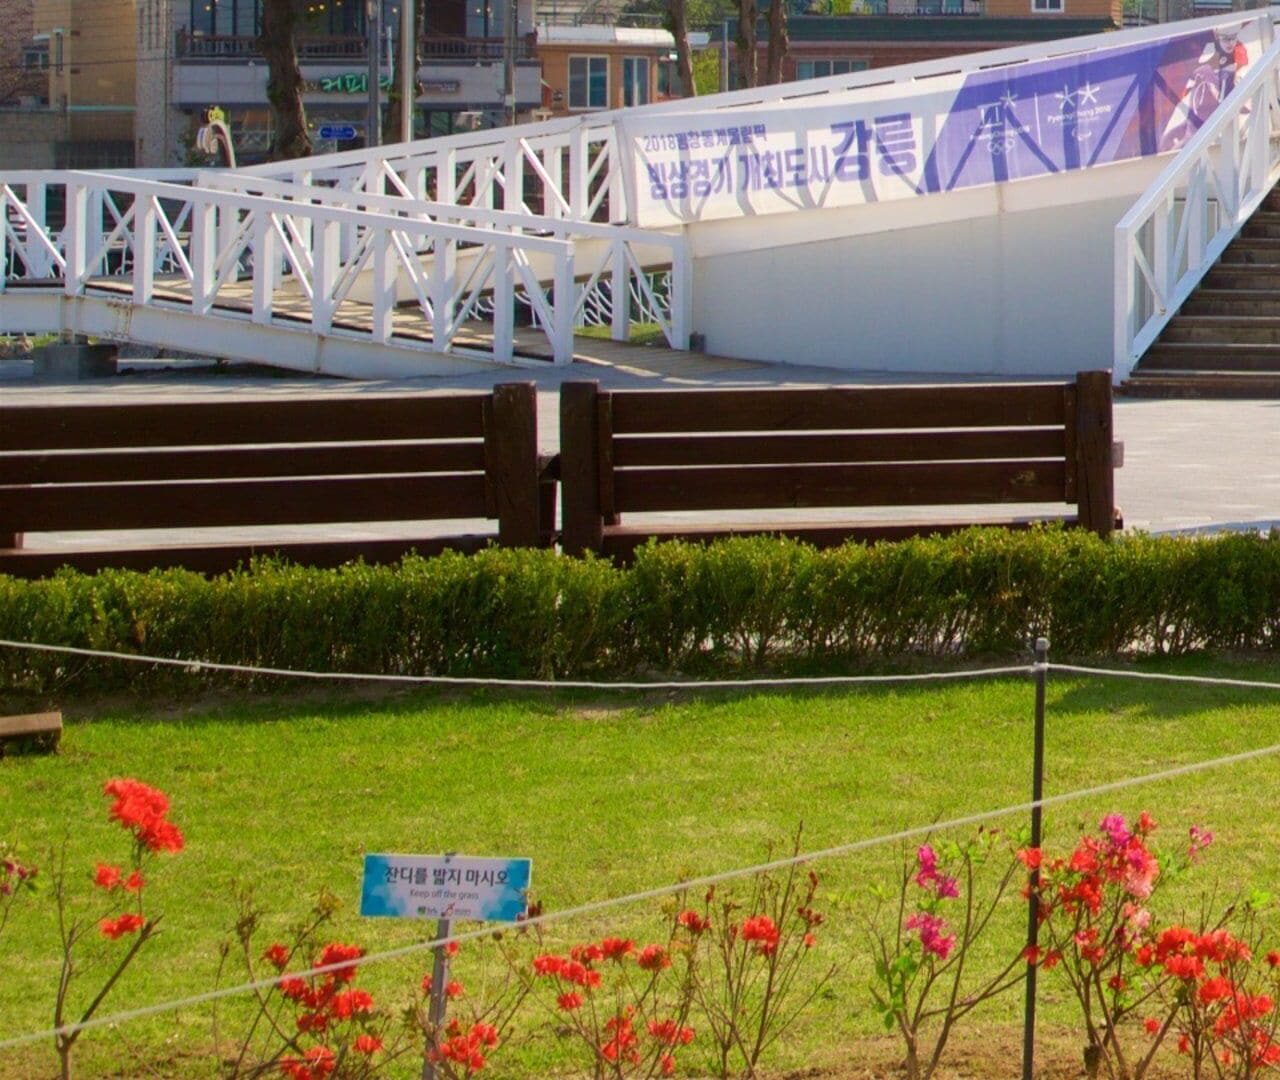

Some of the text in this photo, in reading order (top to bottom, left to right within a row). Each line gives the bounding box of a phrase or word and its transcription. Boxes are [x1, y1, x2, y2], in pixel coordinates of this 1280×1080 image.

[647, 112, 918, 201] 빙상경기 개최도시 강릉
[385, 866, 429, 885] 잔디를
[465, 868, 511, 887] 마시오
[410, 888, 480, 901] Keep off the grass
